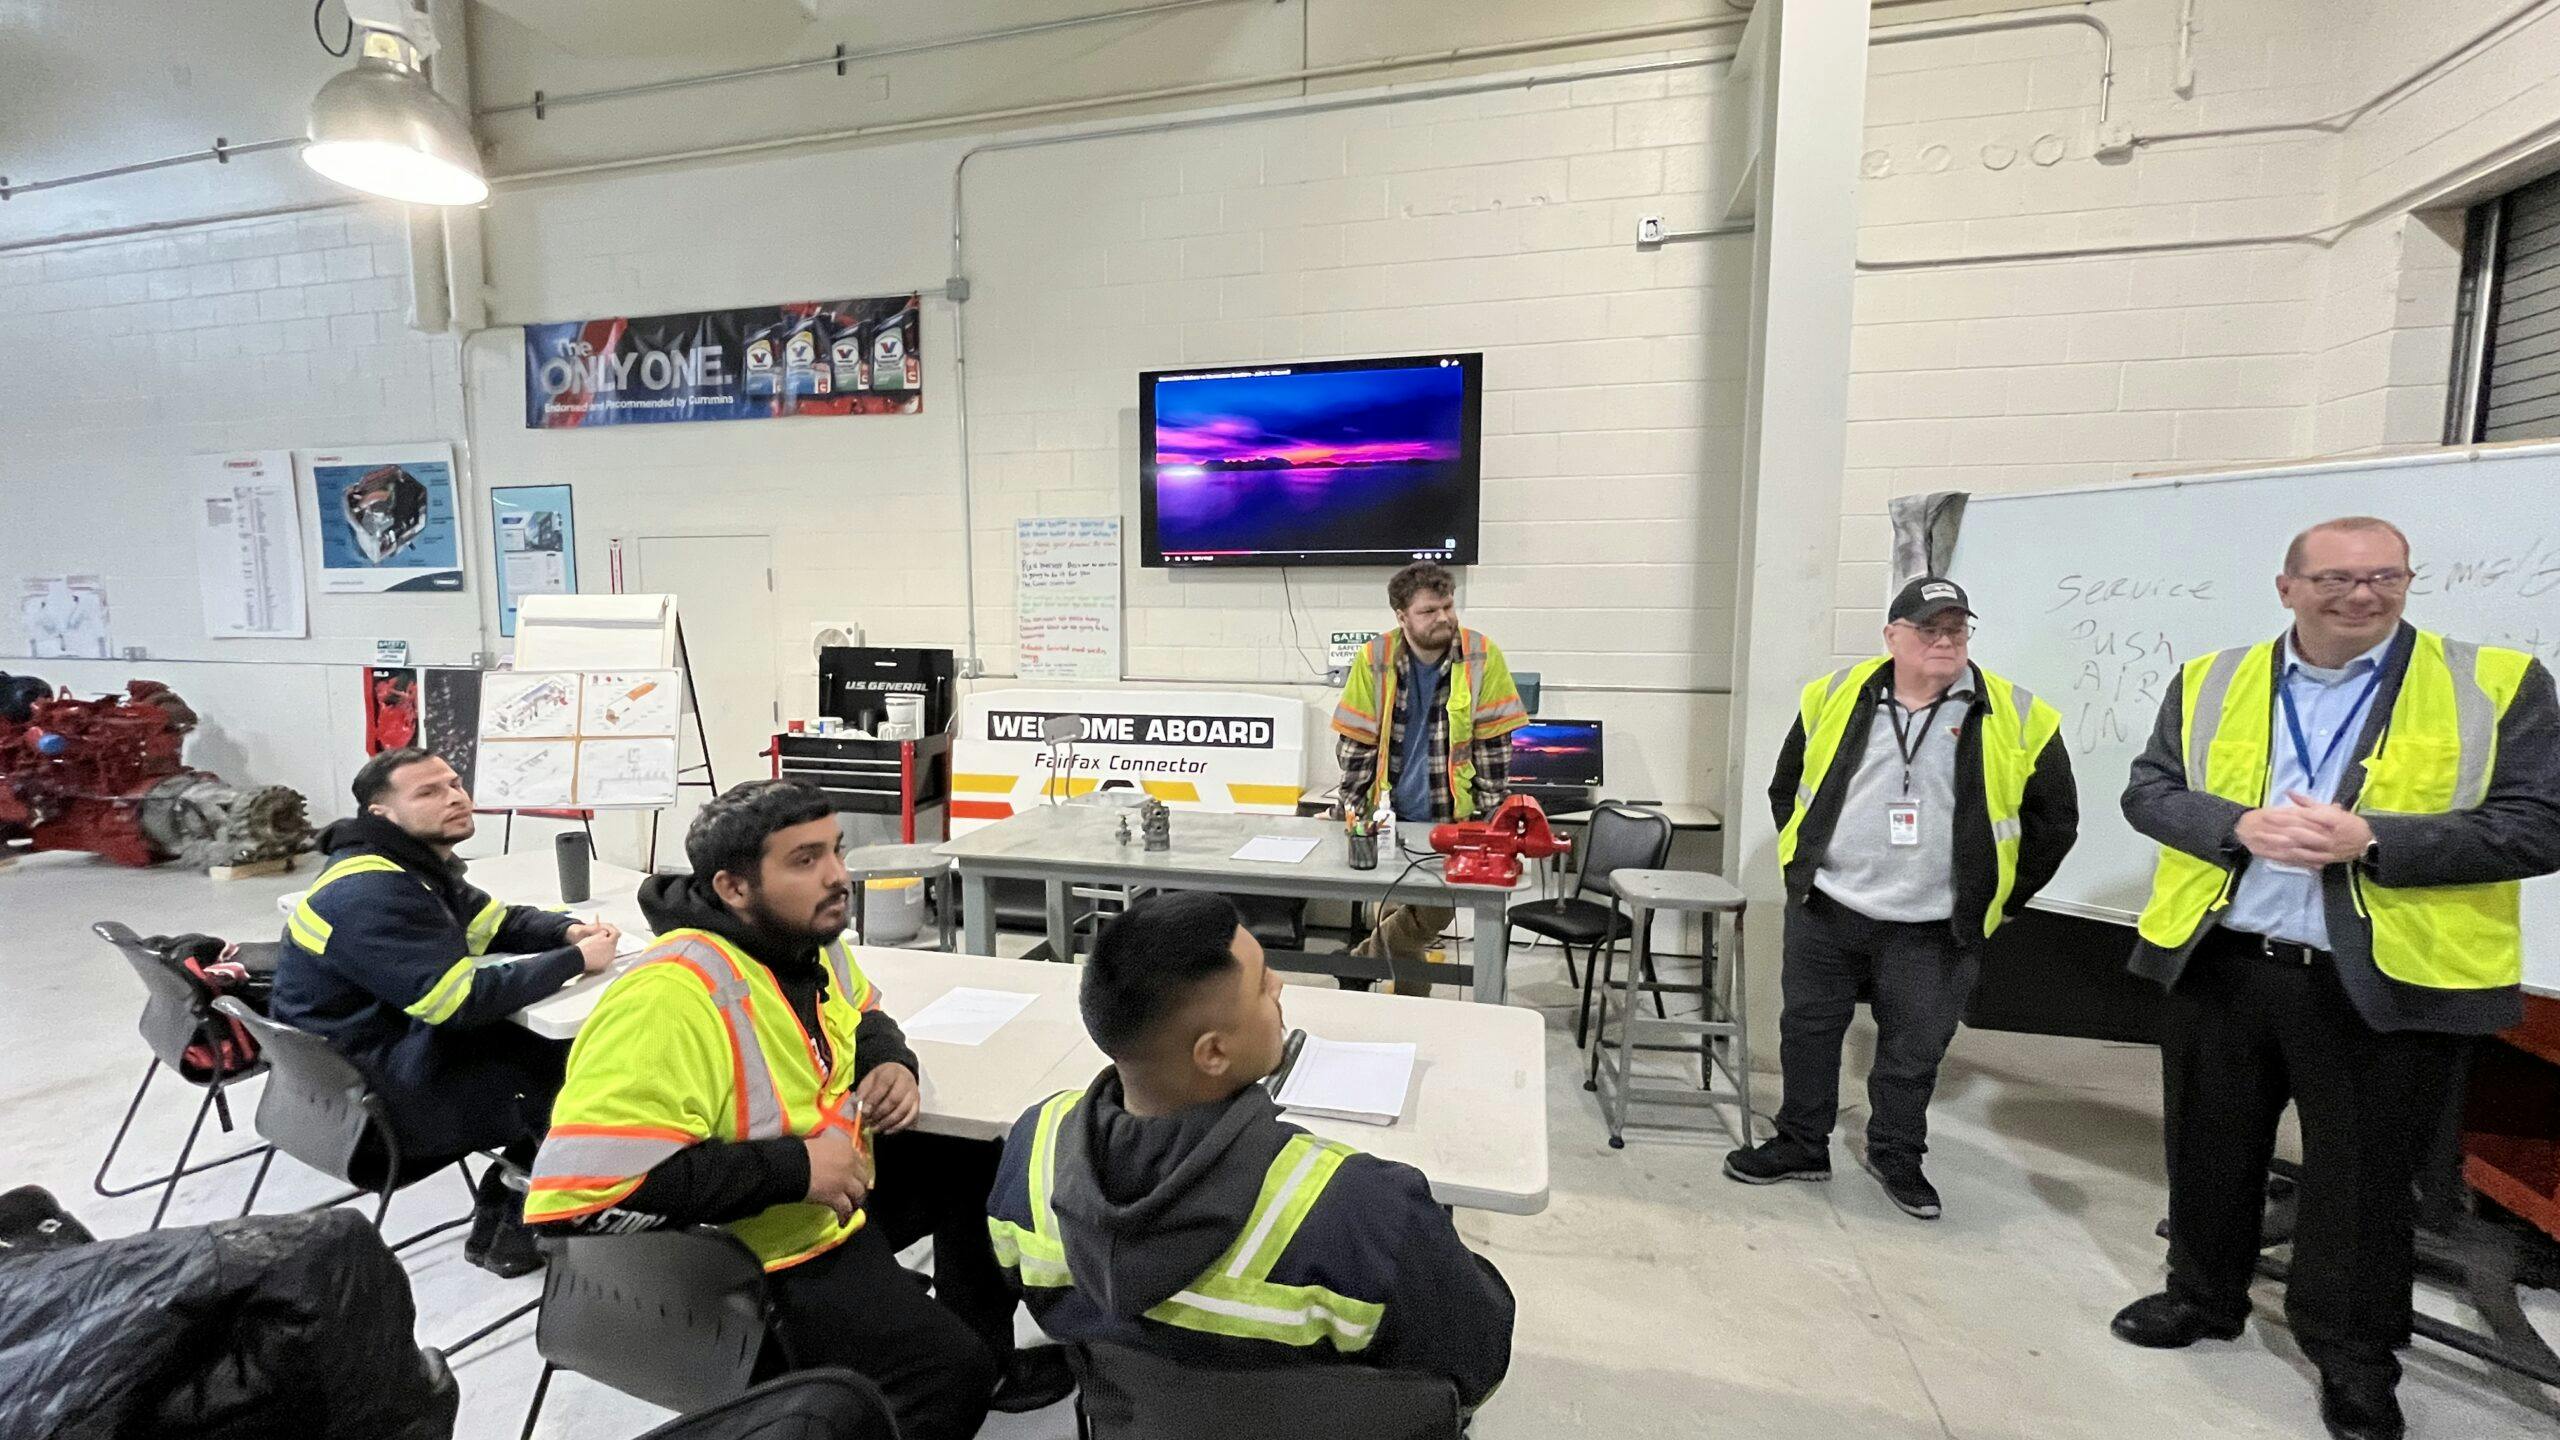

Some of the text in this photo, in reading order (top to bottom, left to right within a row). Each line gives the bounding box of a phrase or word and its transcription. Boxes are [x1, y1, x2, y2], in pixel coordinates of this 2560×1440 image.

[541, 345, 733, 395] ONLY ONE.
[544, 402, 588, 413] Endorsed
[606, 397, 675, 409] Recommended
[676, 396, 687, 408] by
[688, 395, 734, 405] Cummins
[1145, 719, 1270, 744] ABOARD
[1035, 753, 1208, 774] Fairfax Connector
